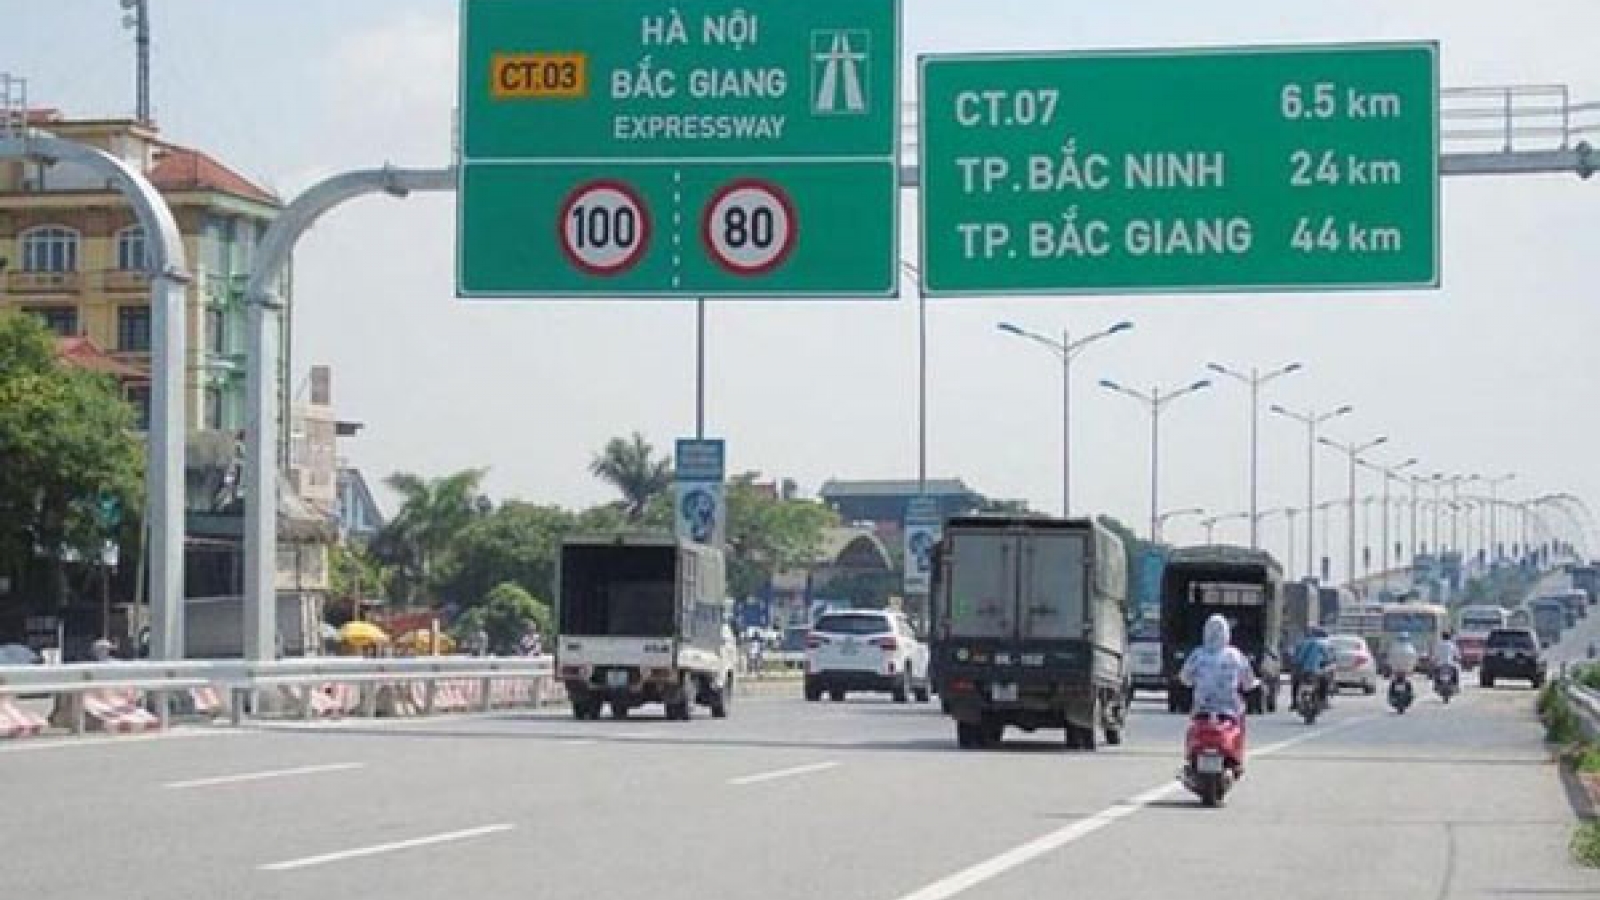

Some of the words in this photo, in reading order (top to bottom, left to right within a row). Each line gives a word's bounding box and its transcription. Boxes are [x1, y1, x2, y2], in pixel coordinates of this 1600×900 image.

[641, 8, 688, 45] HÀ
[703, 8, 758, 51] NỘI
[500, 61, 577, 91] CT.03
[611, 54, 676, 99] BẮC
[689, 68, 787, 99] GIANG
[955, 89, 1059, 126] CT.07
[1280, 83, 1336, 118] 6.5
[1347, 88, 1401, 118] km
[614, 115, 785, 139] EXPRESSWAY
[1125, 152, 1225, 188] NINH
[1289, 150, 1339, 186] 24
[1348, 155, 1401, 184] km
[573, 206, 636, 249] 100
[724, 206, 774, 249] 80
[957, 222, 1017, 259] TP.
[1028, 205, 1110, 257] BẮC
[1124, 217, 1253, 254] GIANG
[1289, 216, 1340, 251] 44
[1348, 222, 1401, 251] km
